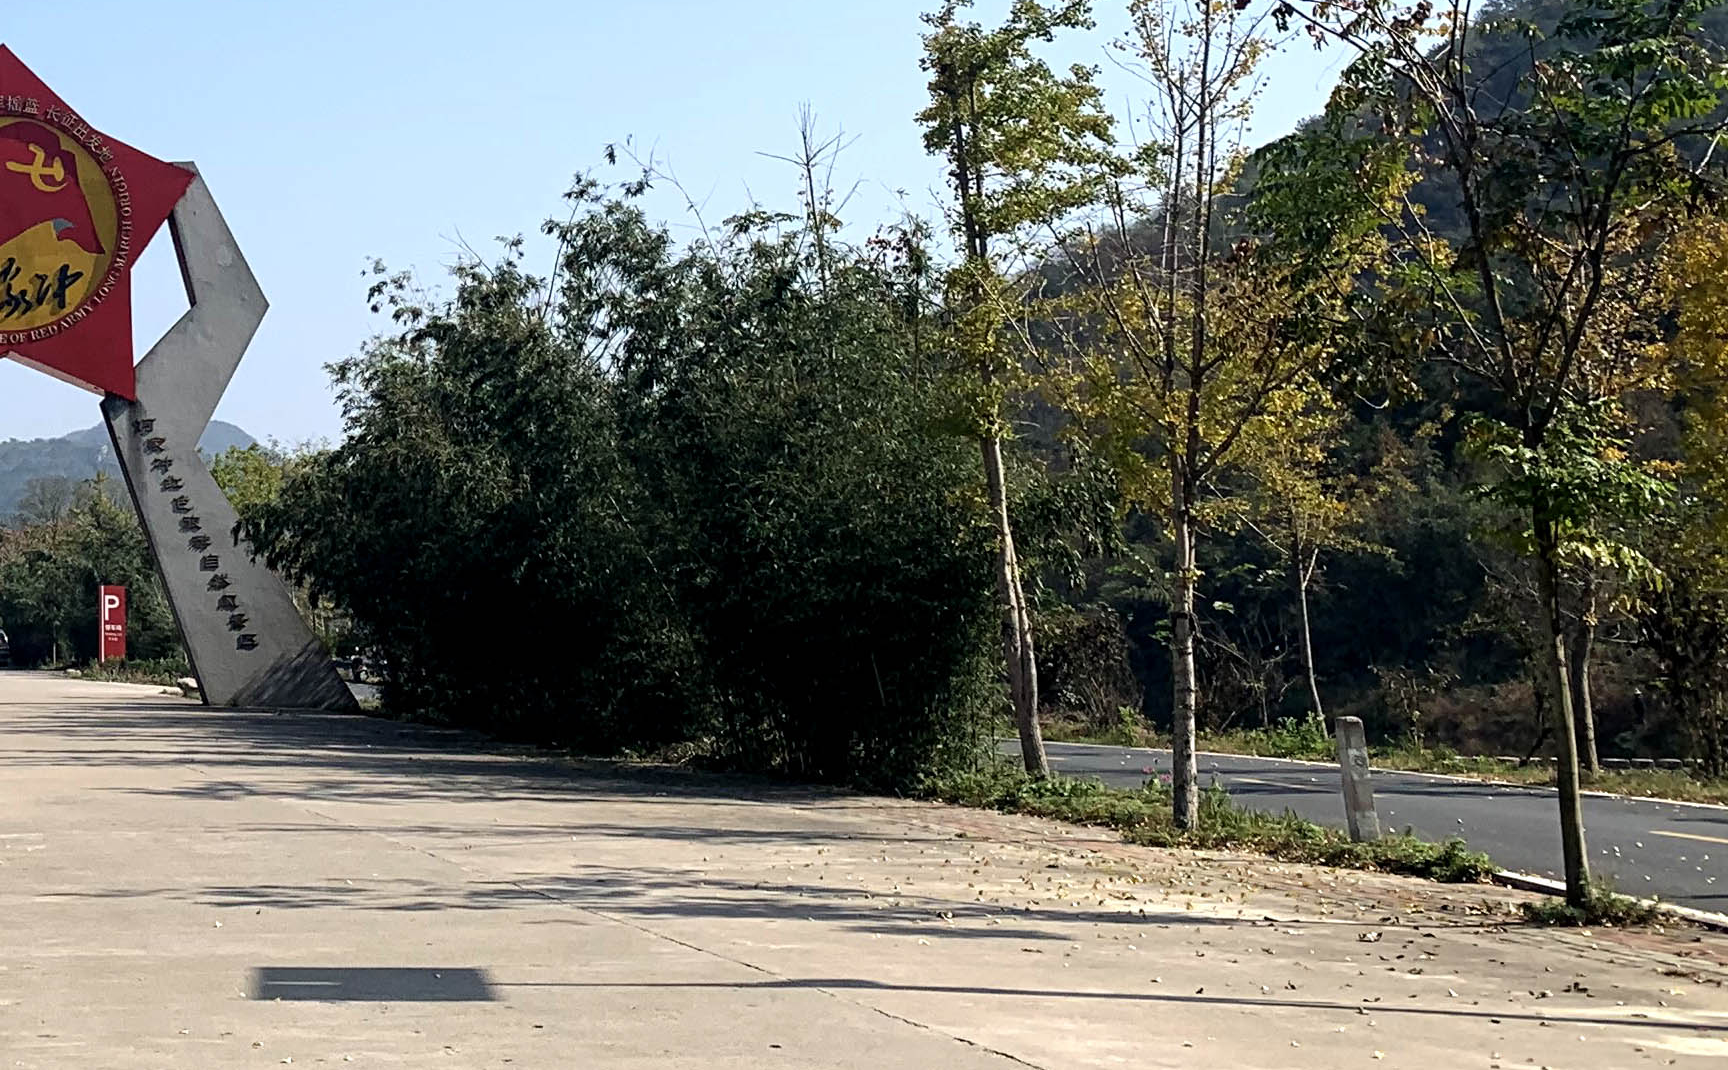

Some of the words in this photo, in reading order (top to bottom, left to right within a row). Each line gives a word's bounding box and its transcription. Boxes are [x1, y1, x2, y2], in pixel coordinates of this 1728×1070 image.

[46, 104, 114, 163] 长征出发地
[93, 271, 120, 304] LONG
[114, 220, 132, 268] MARCH
[9, 331, 28, 343] OF
[31, 325, 57, 341] RED
[60, 302, 93, 327] ARMY
[104, 594, 120, 621] P
